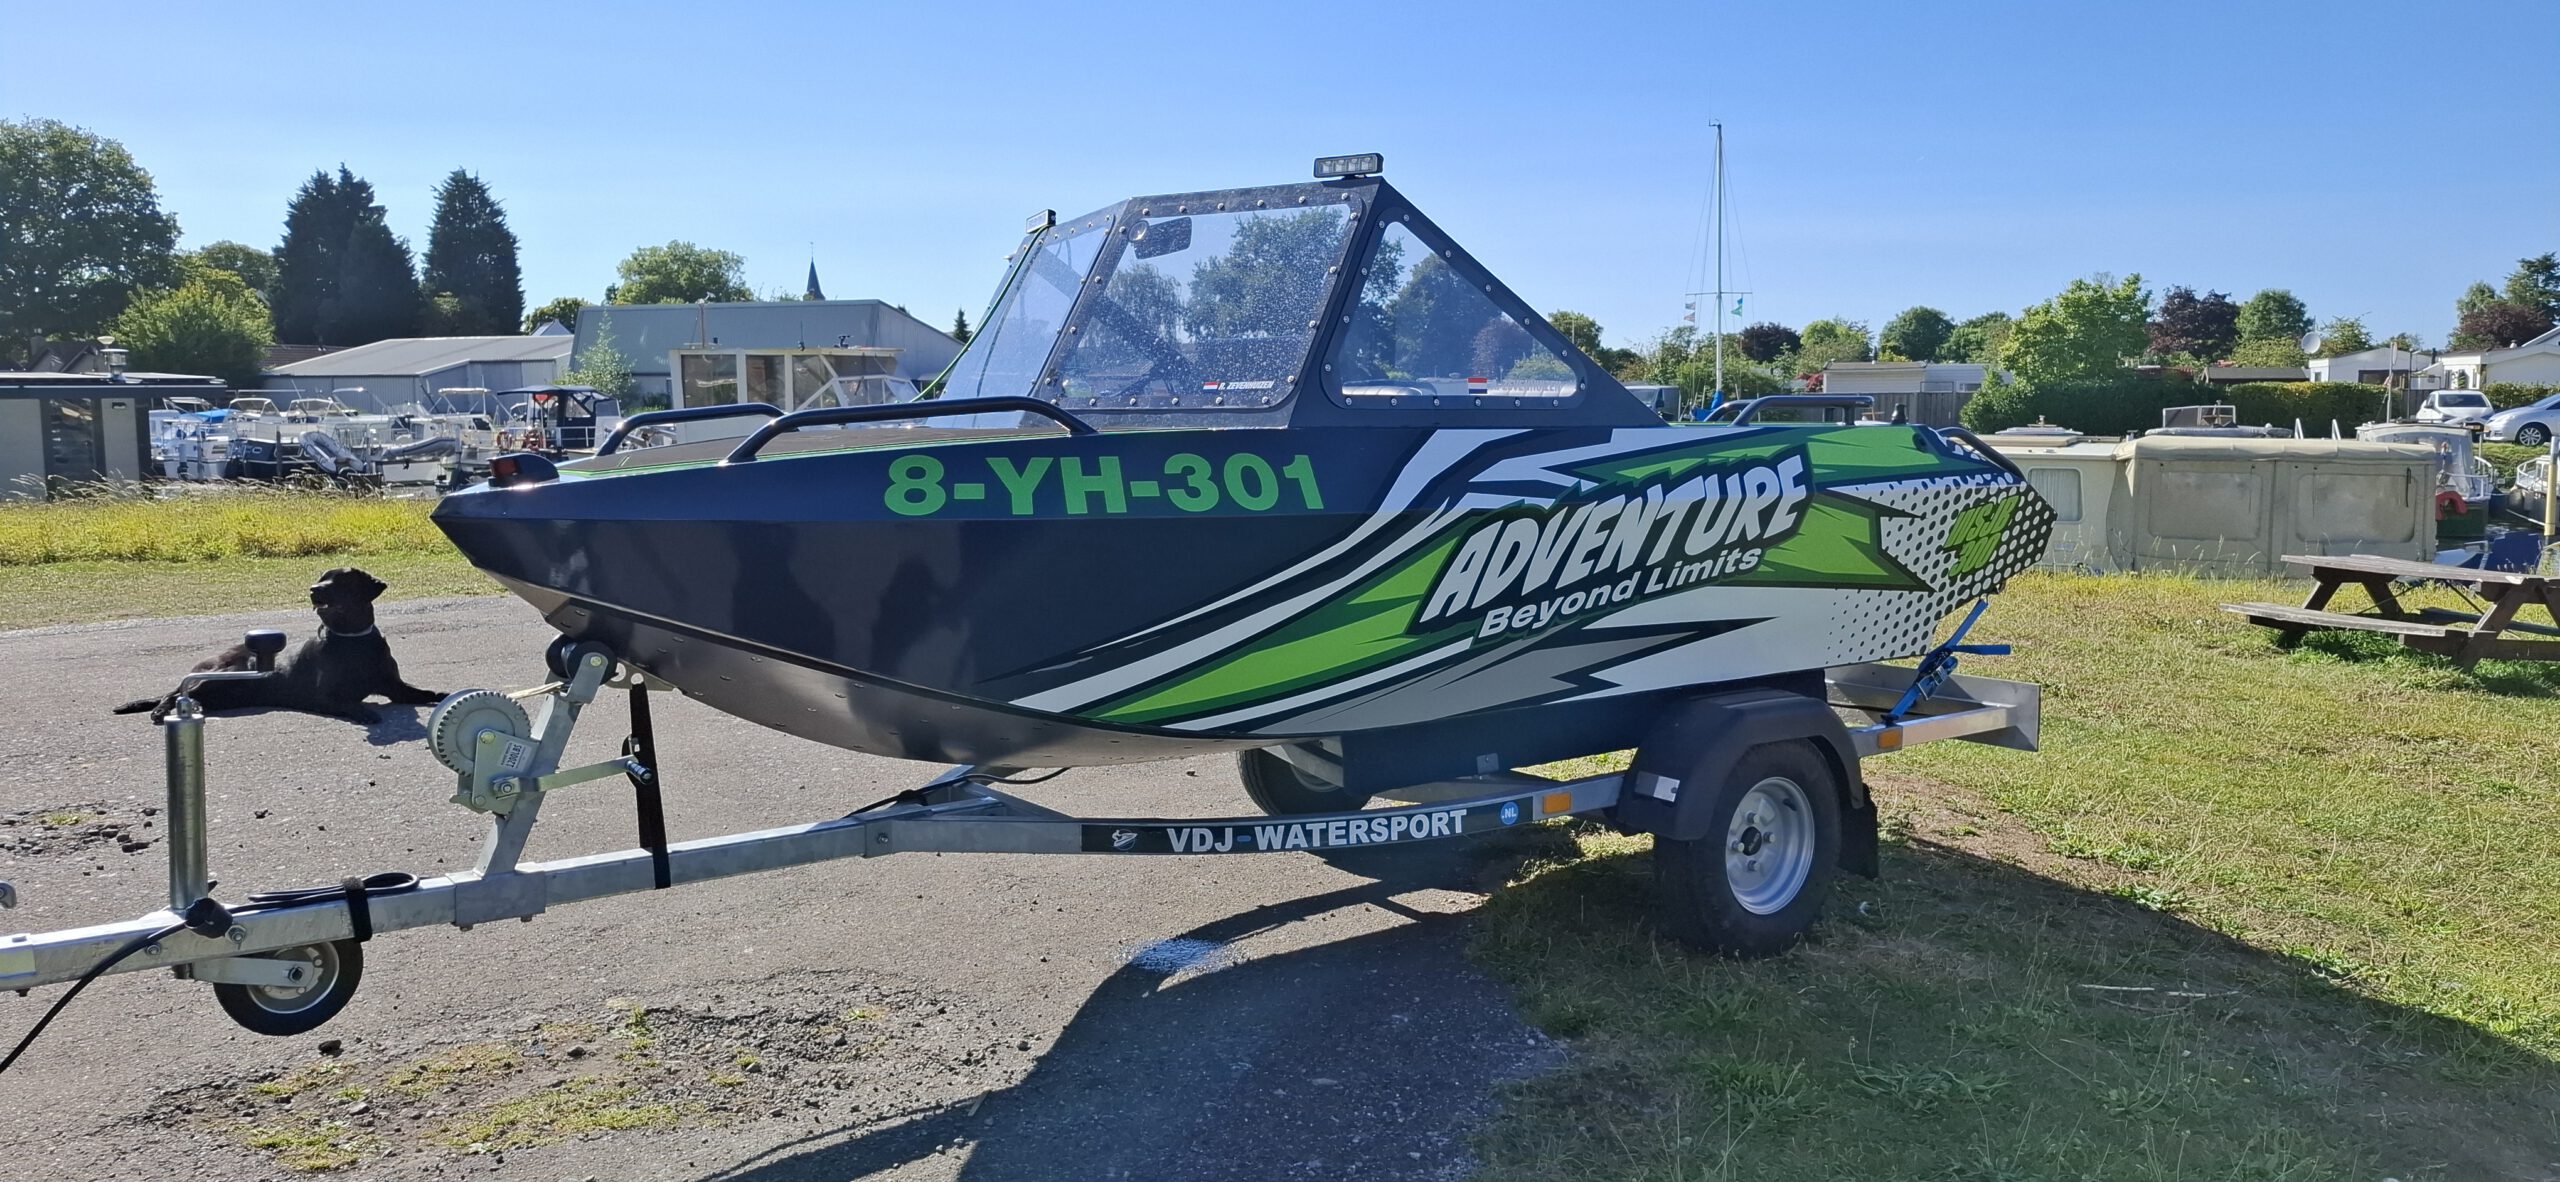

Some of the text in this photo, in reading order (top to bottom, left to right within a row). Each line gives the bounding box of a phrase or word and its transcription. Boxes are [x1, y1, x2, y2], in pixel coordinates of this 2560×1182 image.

[884, 453, 1324, 515] 8-YH-301
[1419, 454, 1806, 623] ADVENTURE
[1943, 495, 2020, 549] WSJB
[1948, 532, 2002, 578] 300
[1478, 547, 1763, 639] Beyond Limits
